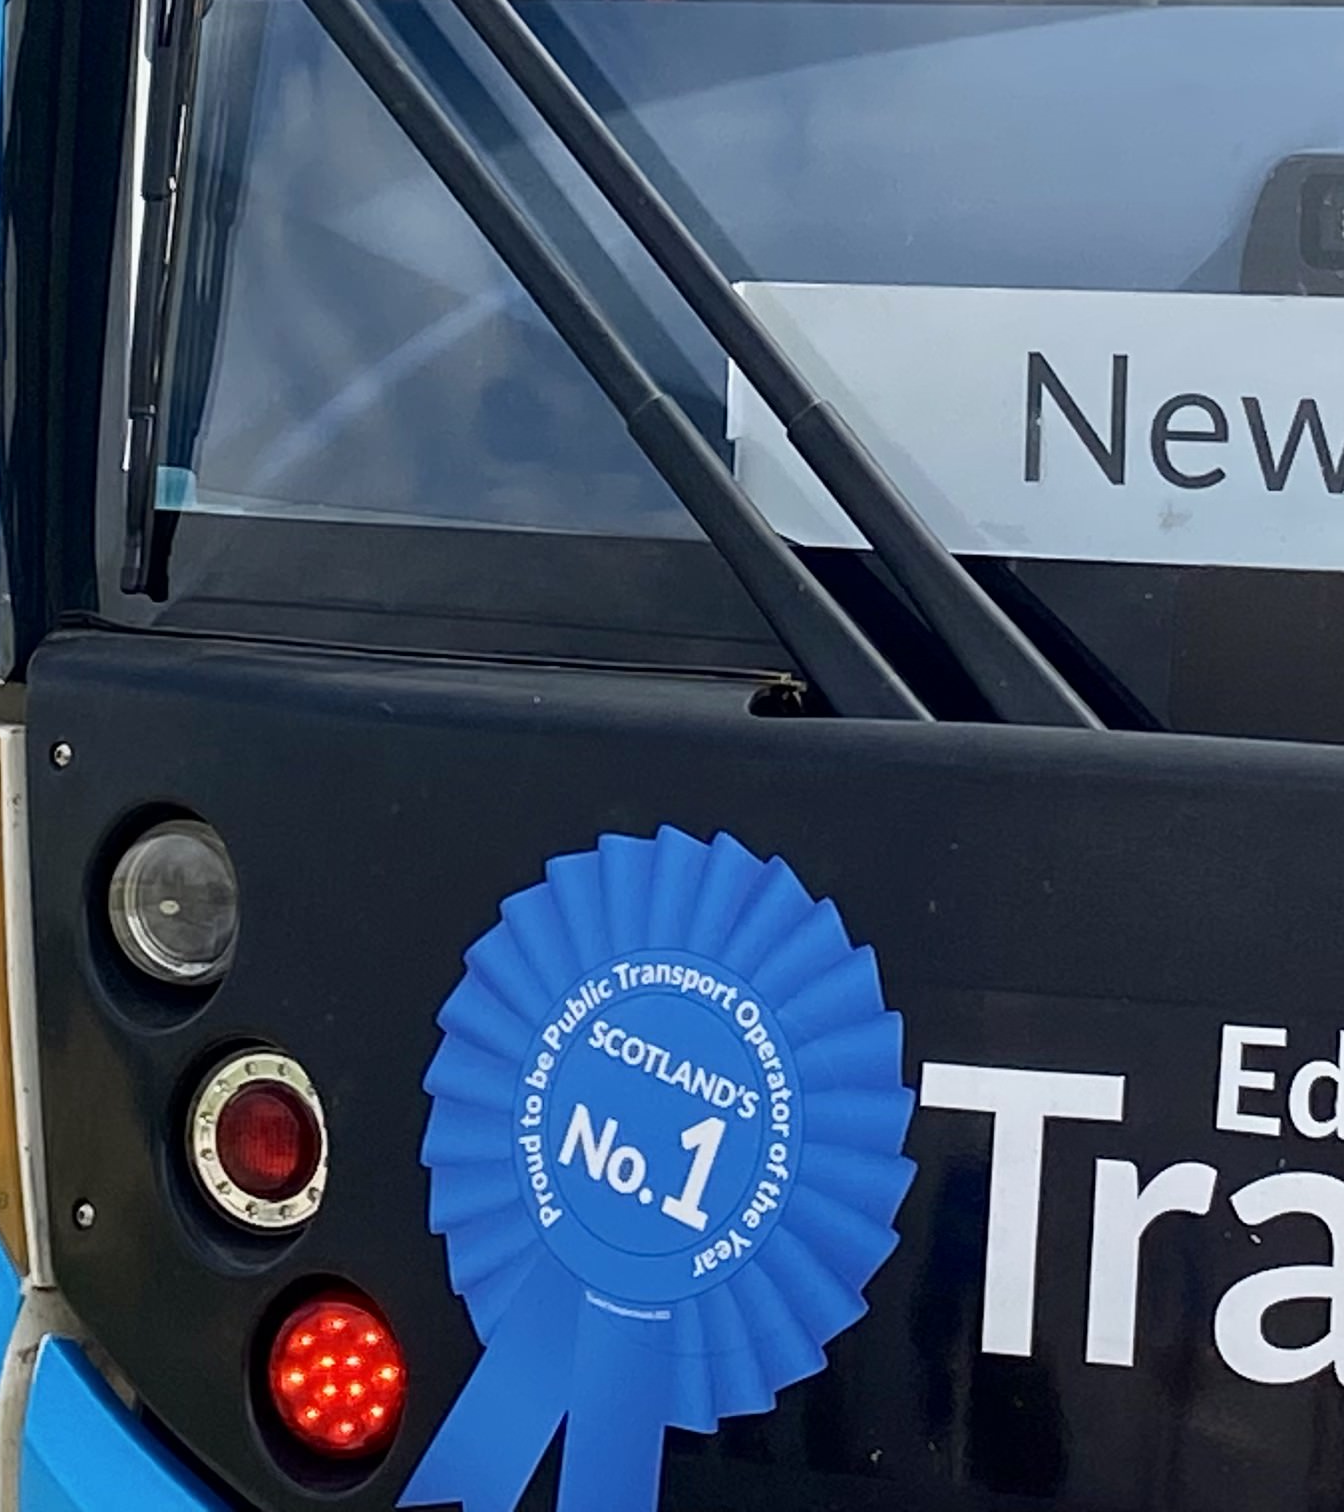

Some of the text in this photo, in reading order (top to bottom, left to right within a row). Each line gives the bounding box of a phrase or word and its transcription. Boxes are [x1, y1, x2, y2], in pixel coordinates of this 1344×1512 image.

[518, 962, 794, 1278] Proud to be Public Transport Operator of the Year
[587, 1019, 761, 1121] SCOTLAND'S
